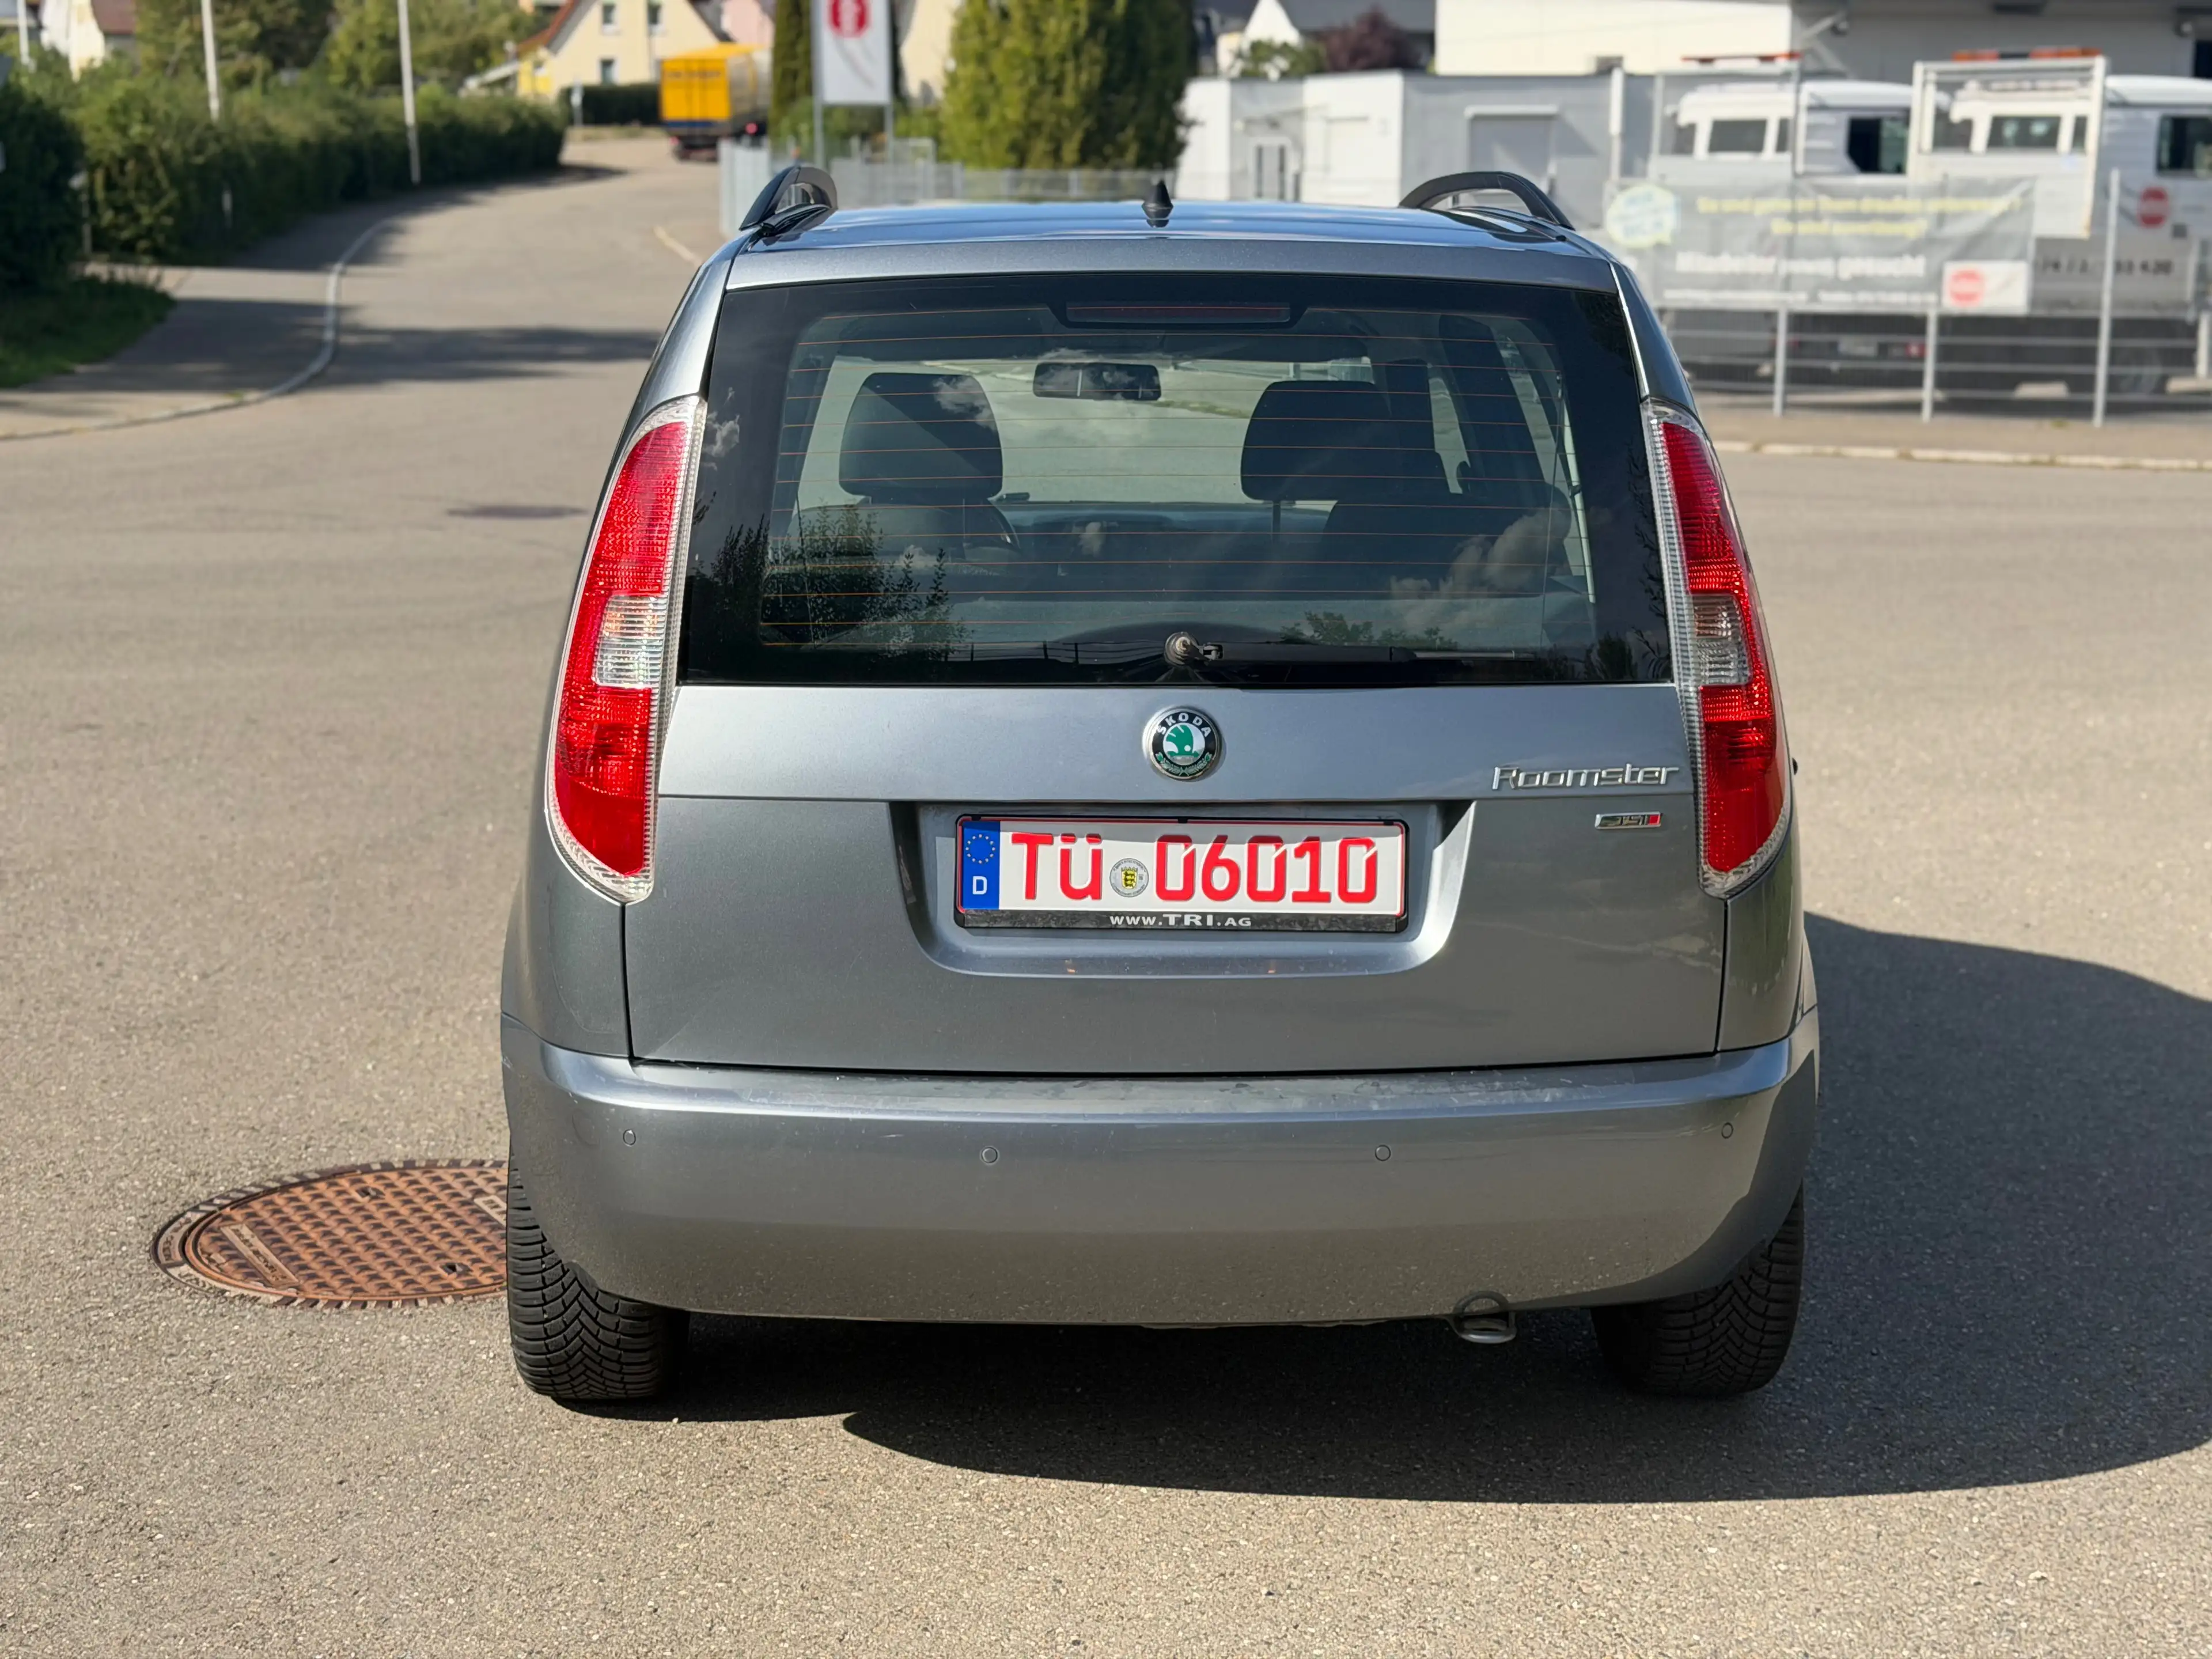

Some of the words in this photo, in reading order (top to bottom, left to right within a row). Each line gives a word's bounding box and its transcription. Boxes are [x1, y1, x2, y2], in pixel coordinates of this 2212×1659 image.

[1492, 763, 1679, 790] Roomster
[1155, 834, 1378, 903] 06010
[972, 876, 987, 895] D
